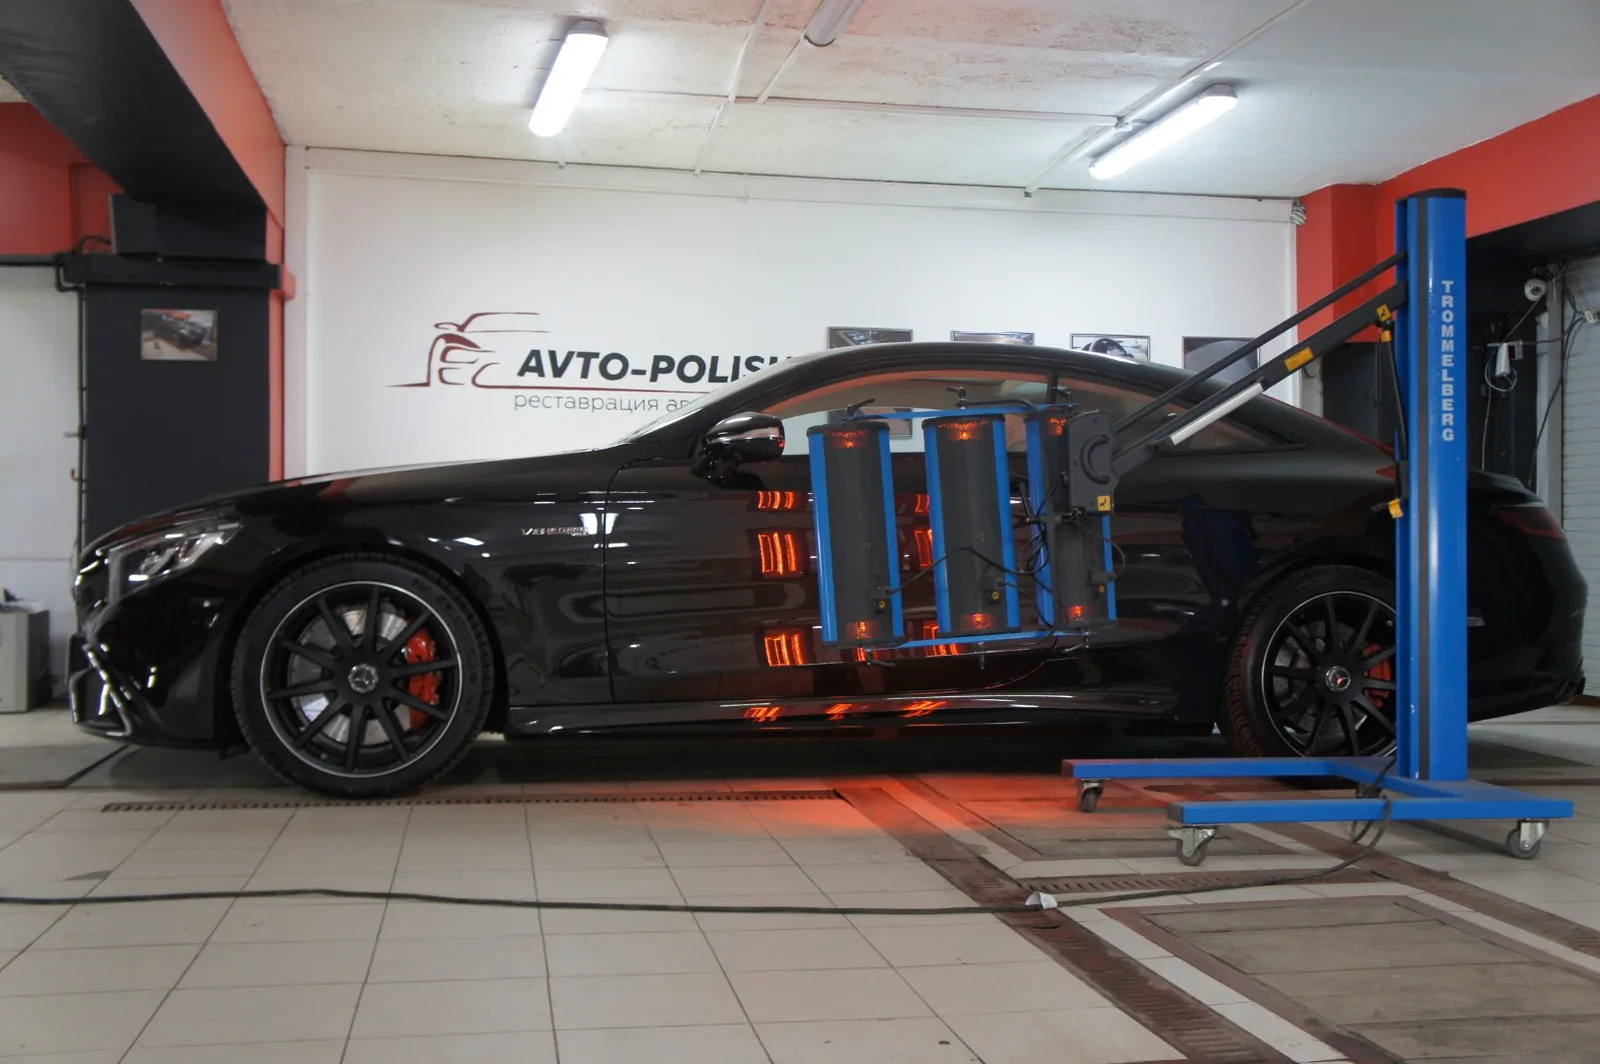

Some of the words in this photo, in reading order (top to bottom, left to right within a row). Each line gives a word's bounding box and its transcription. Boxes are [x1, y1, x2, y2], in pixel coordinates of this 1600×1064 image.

[517, 349, 792, 383] AVTO-POLIS
[1441, 280, 1454, 442] TROMMELBERG
[514, 394, 659, 413] реставрация
